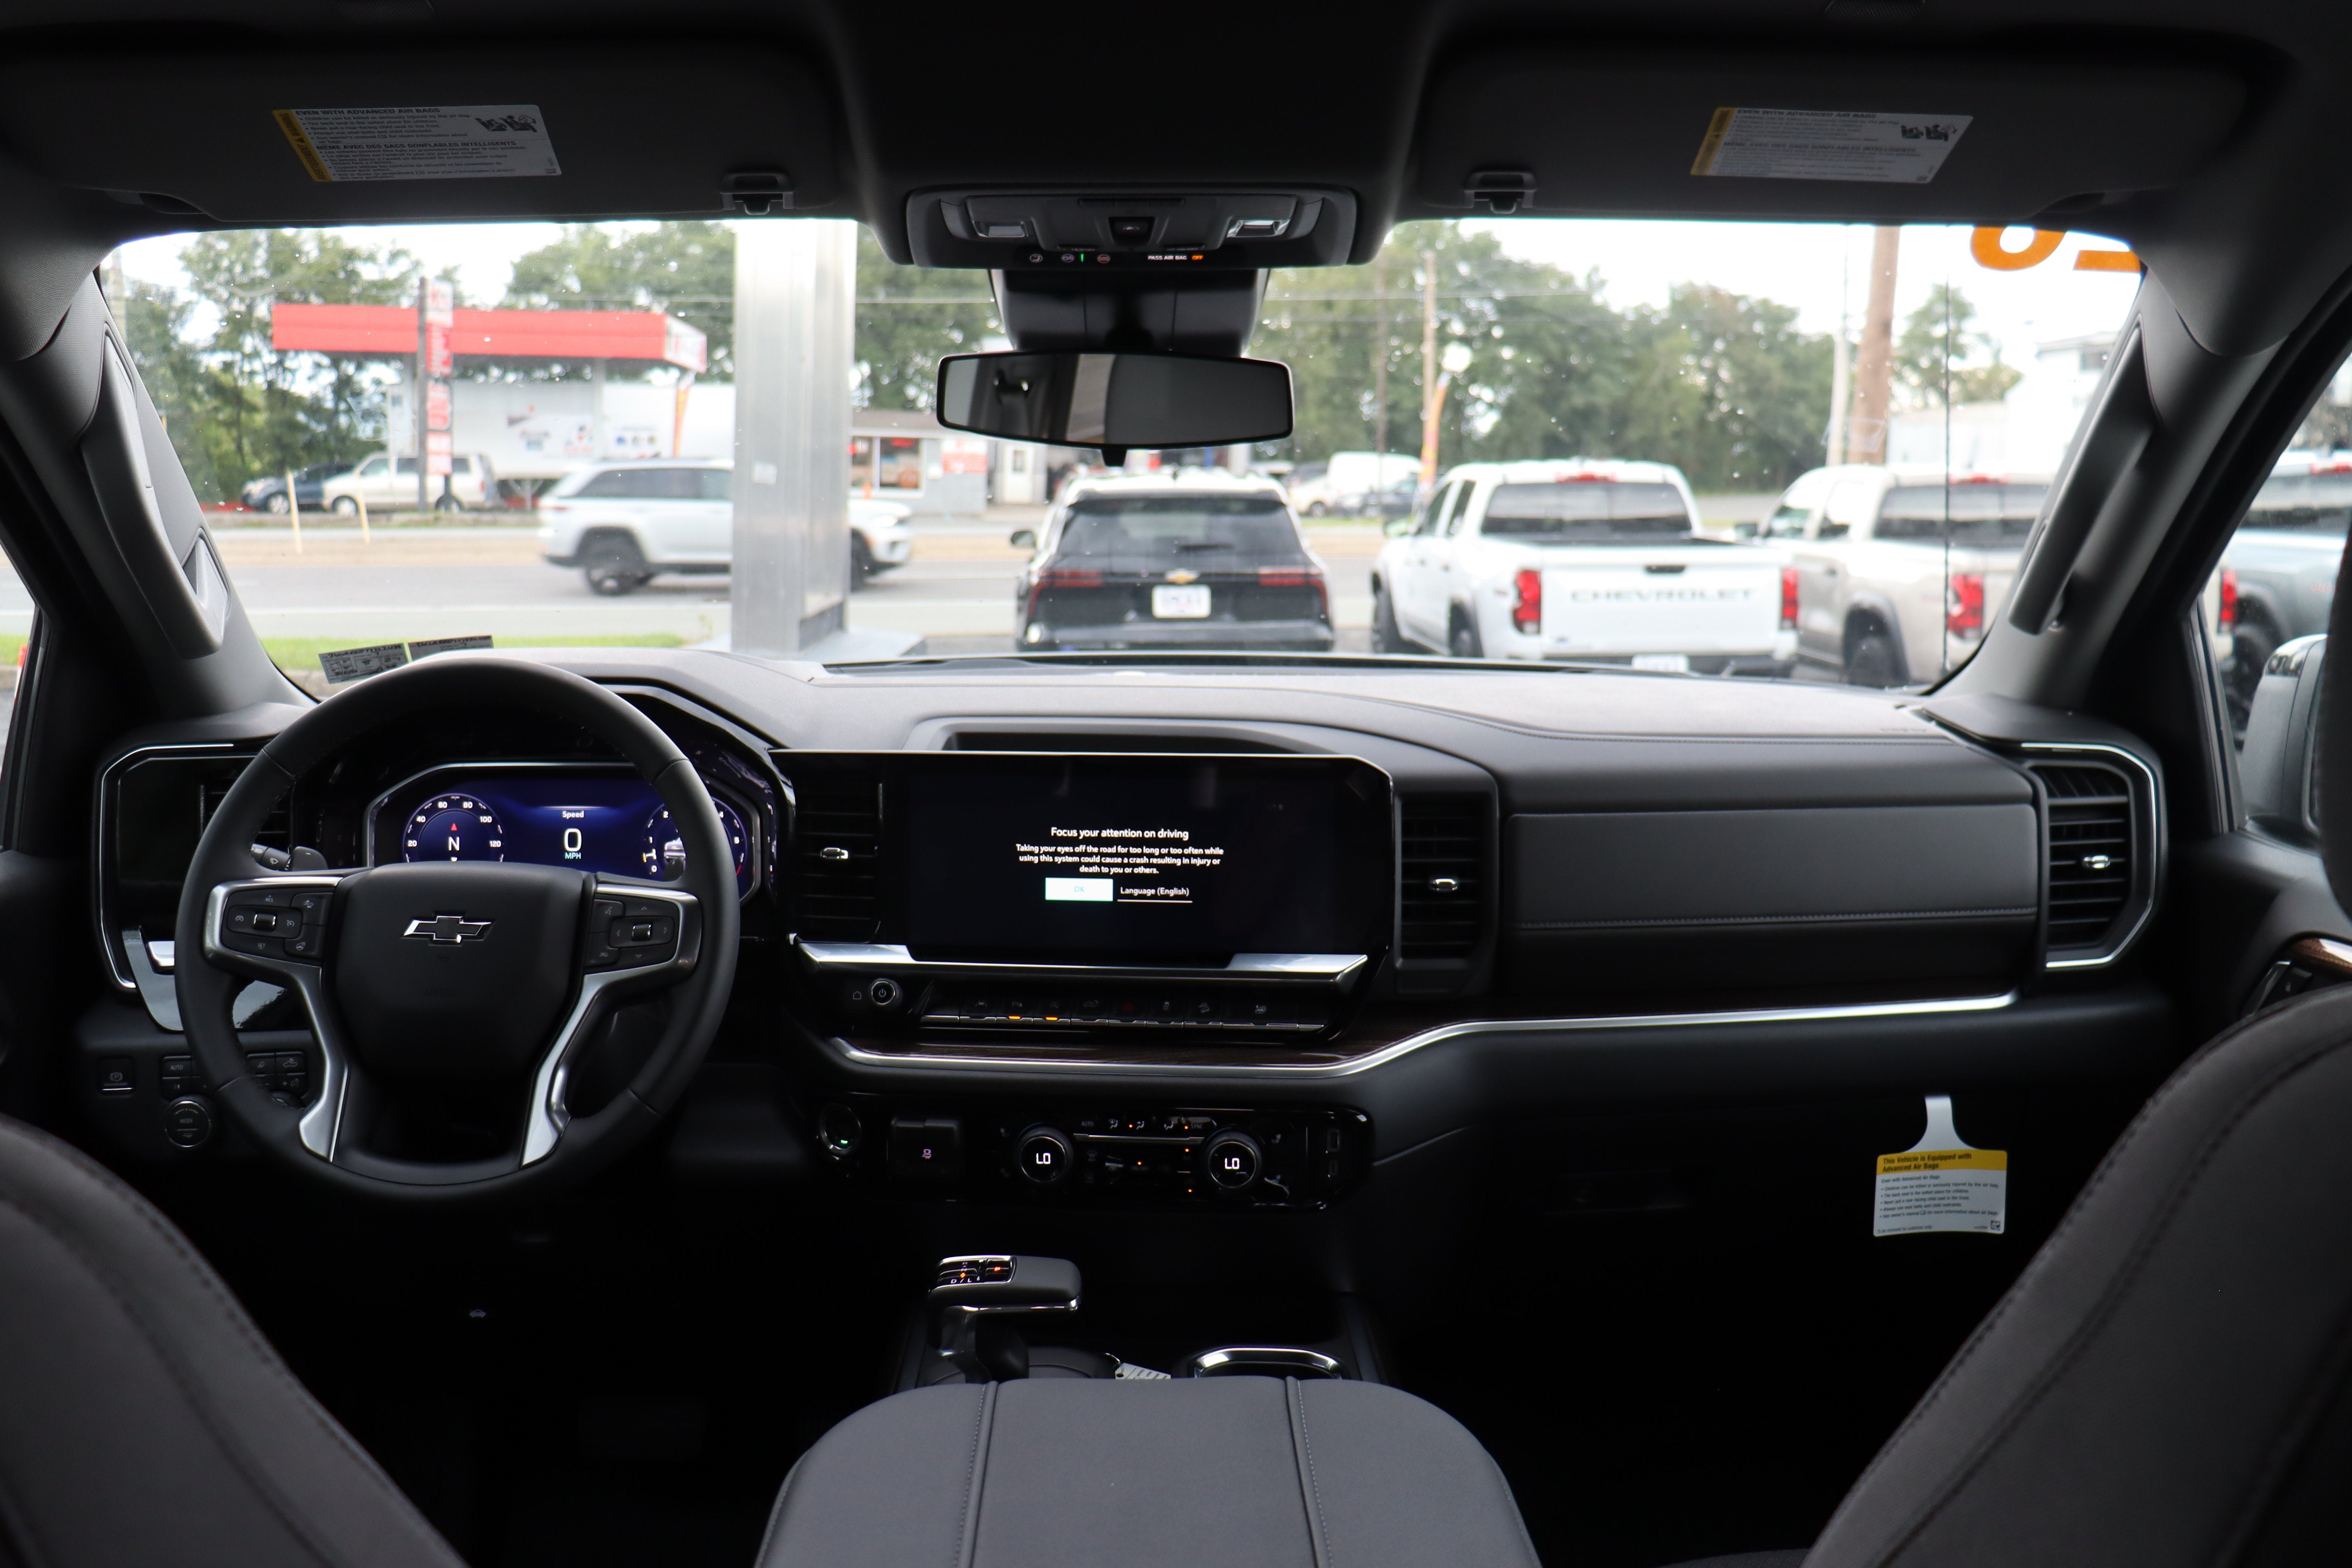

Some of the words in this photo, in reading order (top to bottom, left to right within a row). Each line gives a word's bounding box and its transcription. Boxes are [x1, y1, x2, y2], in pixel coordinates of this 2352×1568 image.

[1571, 588, 1753, 601] CHEVROLET
[563, 811, 584, 819] Speed
[1051, 827, 1077, 837] Focus
[1079, 829, 1099, 839] your
[1101, 828, 1142, 837] attention
[1158, 829, 1189, 840] driving
[448, 836, 460, 851] N
[564, 828, 581, 851] 0
[1016, 844, 1039, 853] Taking
[1143, 846, 1159, 855] long
[1019, 855, 1038, 864] using
[1150, 856, 1181, 866] resulting
[1191, 858, 1211, 866] injury
[1120, 887, 1155, 896] Language
[1157, 888, 1189, 897] (English)
[1036, 1153, 1051, 1165] LO
[1224, 1158, 1240, 1169] LO
